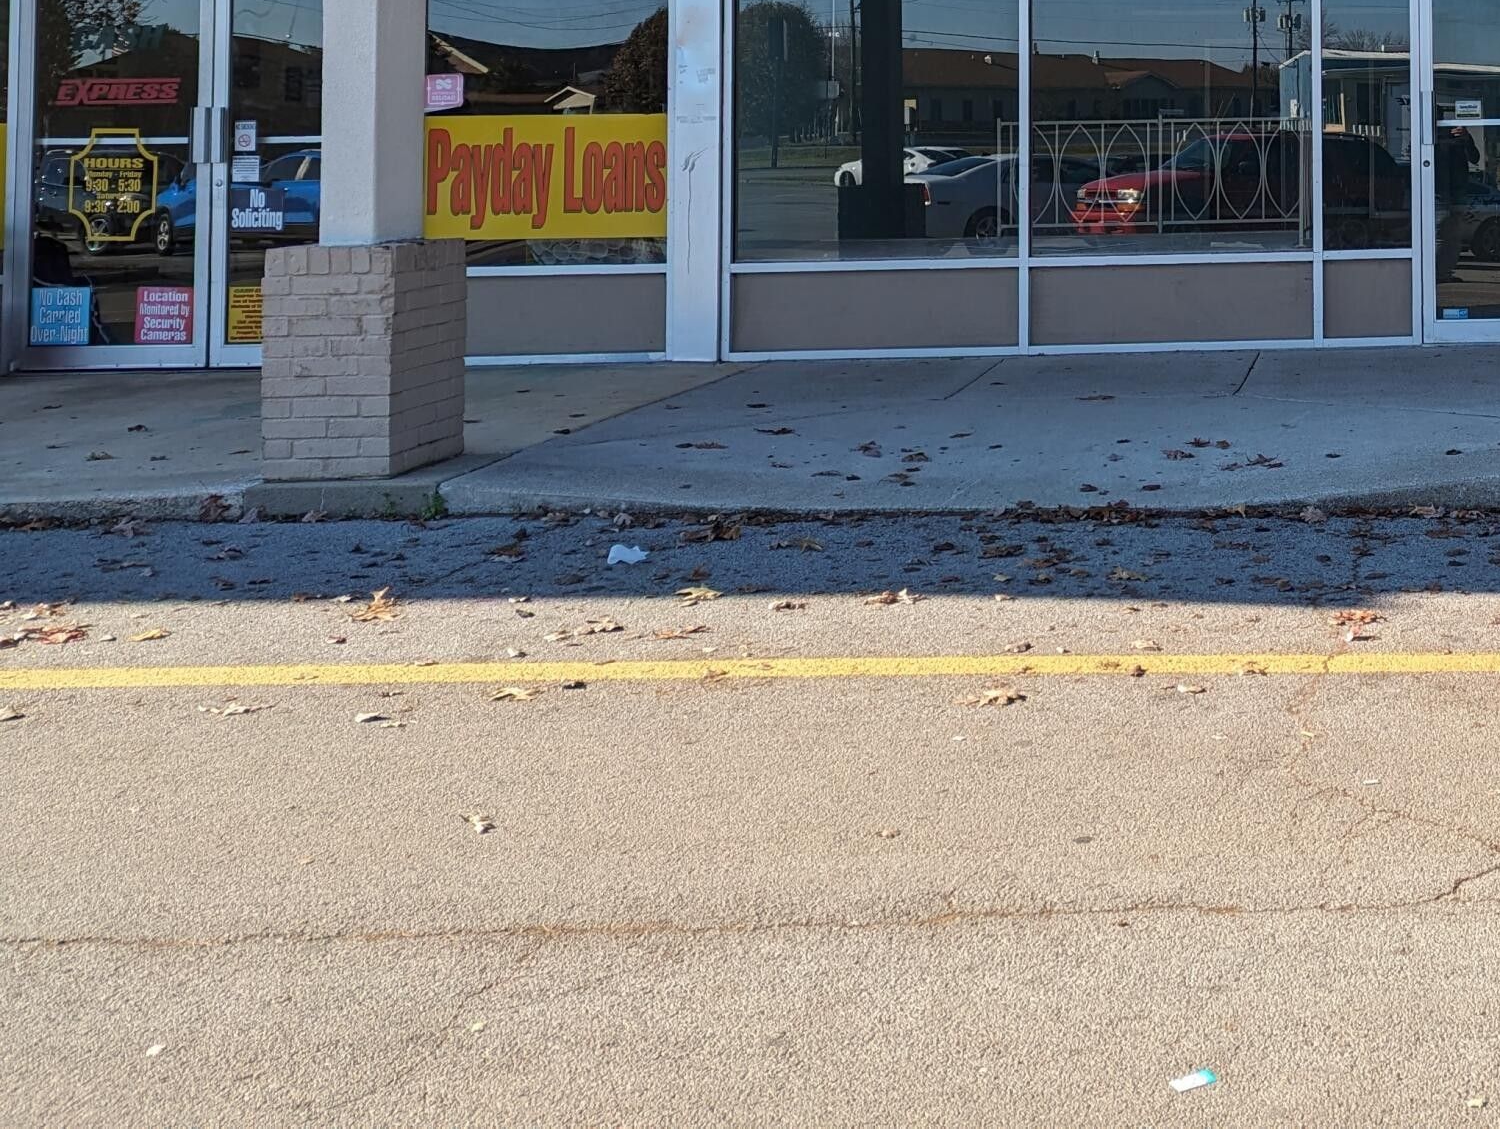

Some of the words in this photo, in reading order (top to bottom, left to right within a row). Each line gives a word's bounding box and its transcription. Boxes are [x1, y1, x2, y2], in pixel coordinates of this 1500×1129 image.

[55, 77, 181, 106] EXPRESS
[84, 158, 144, 168] HOURS
[427, 127, 554, 229] Payday
[563, 126, 667, 214] Loans
[86, 179, 108, 192] 9:30
[118, 179, 141, 192] 5:30
[249, 189, 266, 208] No
[117, 200, 140, 213] 2:00
[231, 208, 283, 231] Soliciting
[40, 289, 53, 305] No
[57, 289, 82, 305] Cash
[144, 291, 188, 302] Location
[40, 307, 81, 324] Carried
[140, 303, 179, 315] Monitored
[181, 303, 190, 318] by
[144, 317, 186, 331] Security
[31, 325, 89, 344] Over-Night
[141, 328, 187, 341] Cameras
